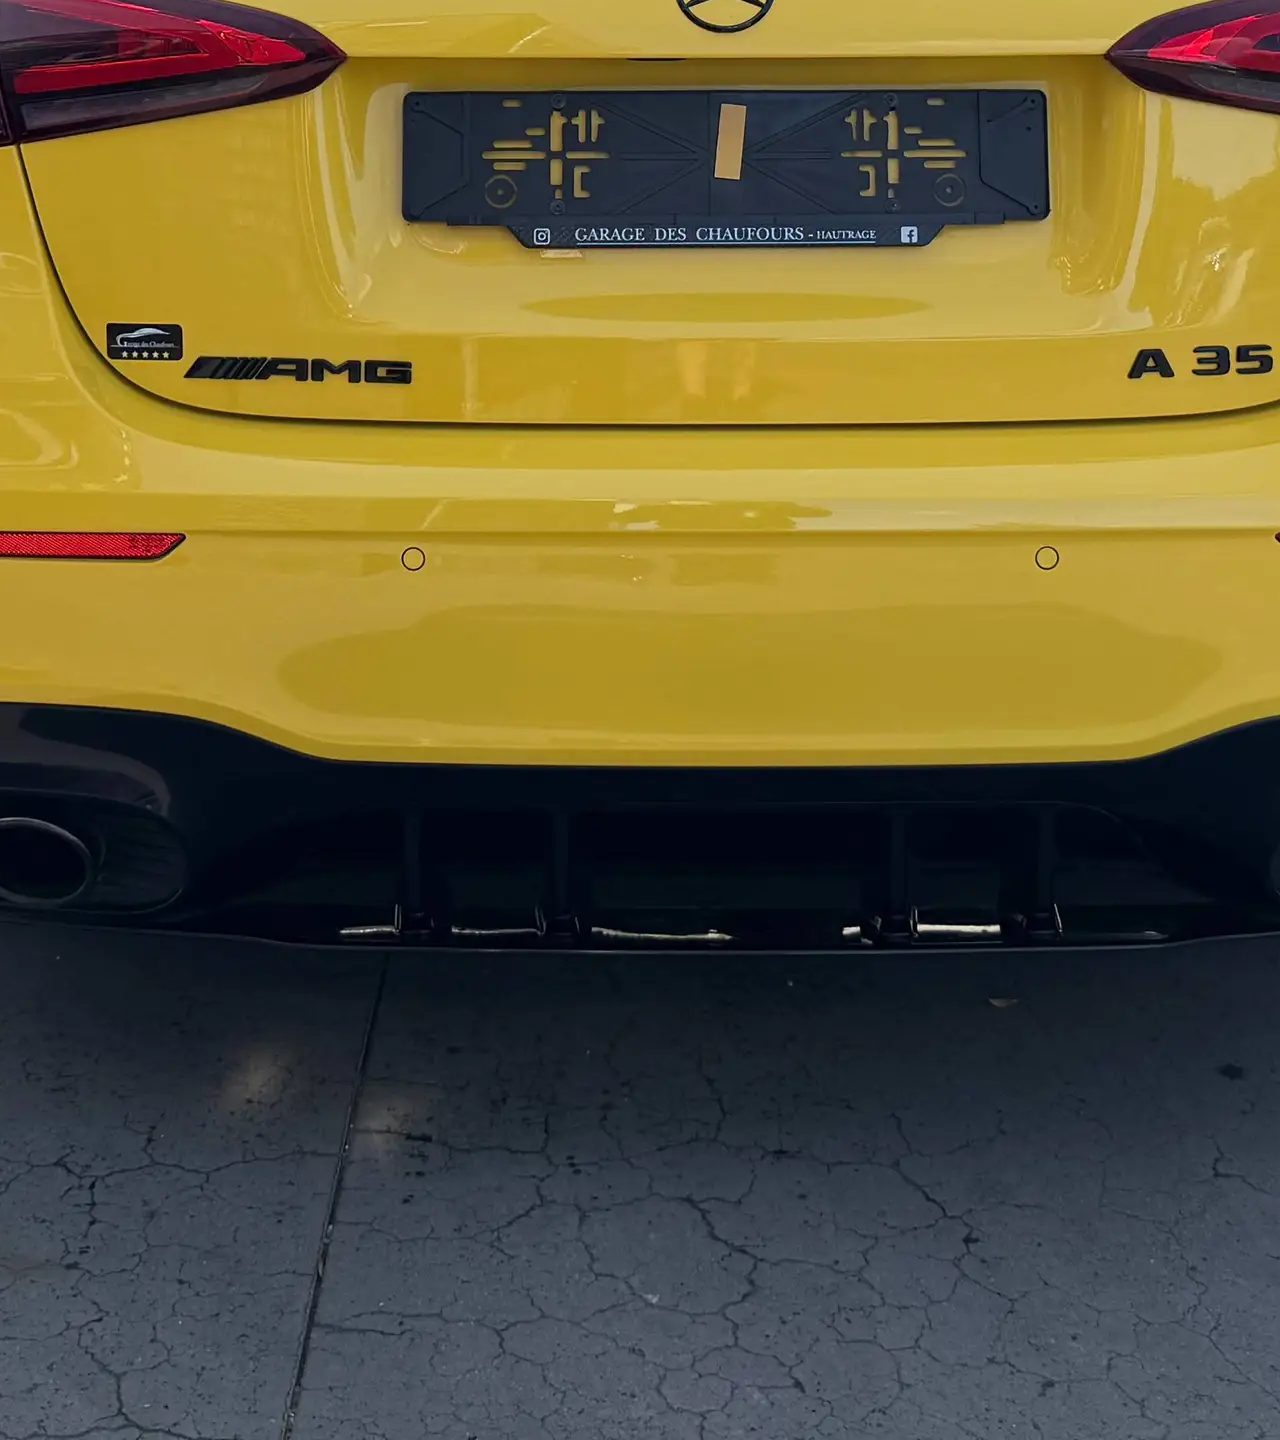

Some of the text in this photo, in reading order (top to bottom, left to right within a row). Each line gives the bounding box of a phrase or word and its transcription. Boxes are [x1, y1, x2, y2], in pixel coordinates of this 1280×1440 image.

[575, 227, 646, 242] GARAGE
[654, 227, 687, 241] DES
[696, 226, 805, 242] CHAUFOURS
[817, 229, 877, 241] HAUTRAGE
[256, 357, 413, 385] AMG
[1127, 343, 1275, 379] A 35
